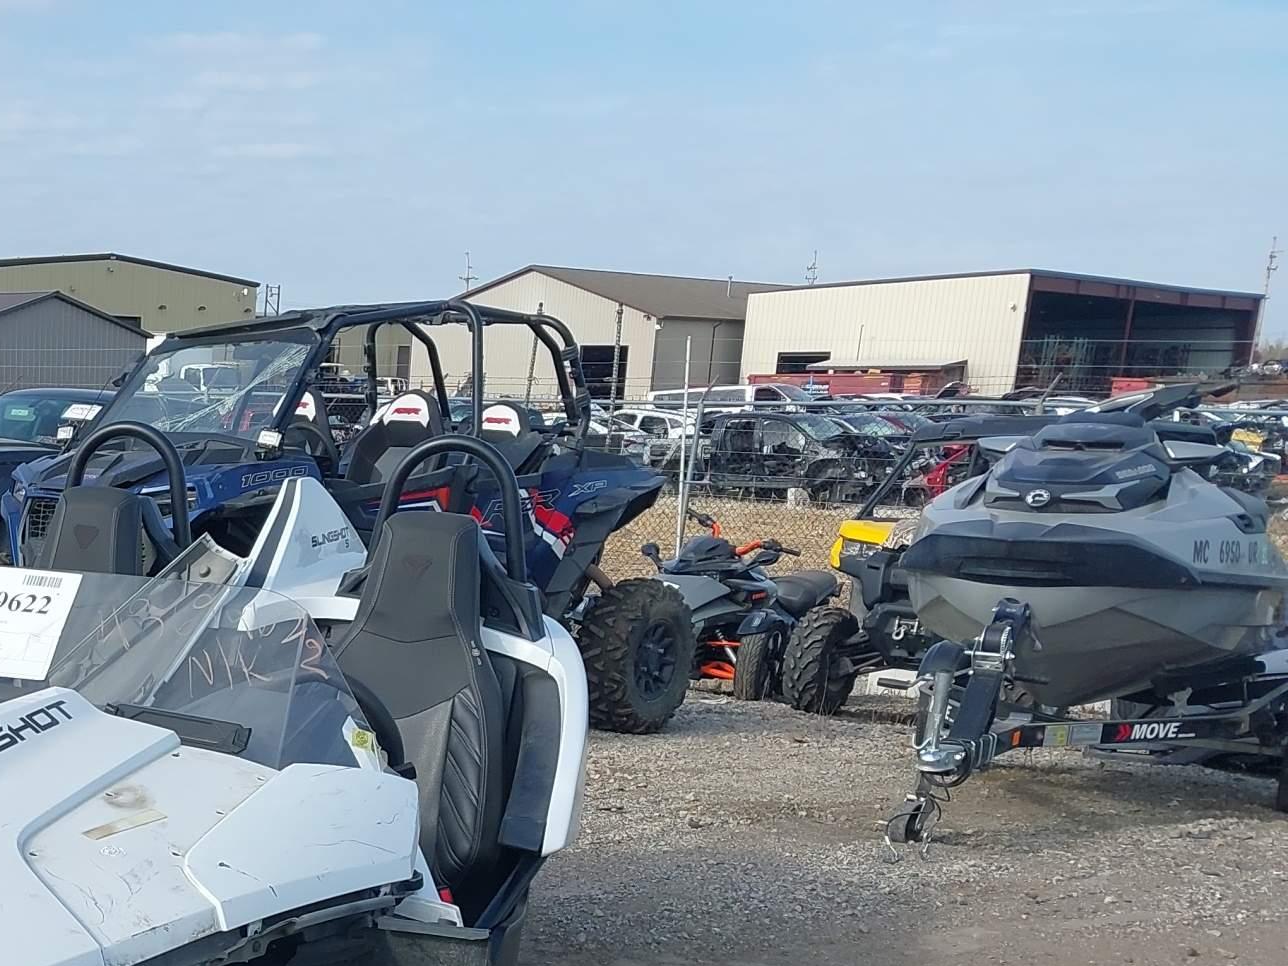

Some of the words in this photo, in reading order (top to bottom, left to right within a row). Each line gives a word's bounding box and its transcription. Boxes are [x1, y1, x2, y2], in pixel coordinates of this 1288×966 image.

[241, 465, 309, 488] 1000
[568, 479, 608, 497] XP
[311, 526, 349, 548] SLINGSHOT
[1193, 540, 1210, 564] MC
[1219, 540, 1241, 564] 6950
[1130, 722, 1182, 740] MOVE
